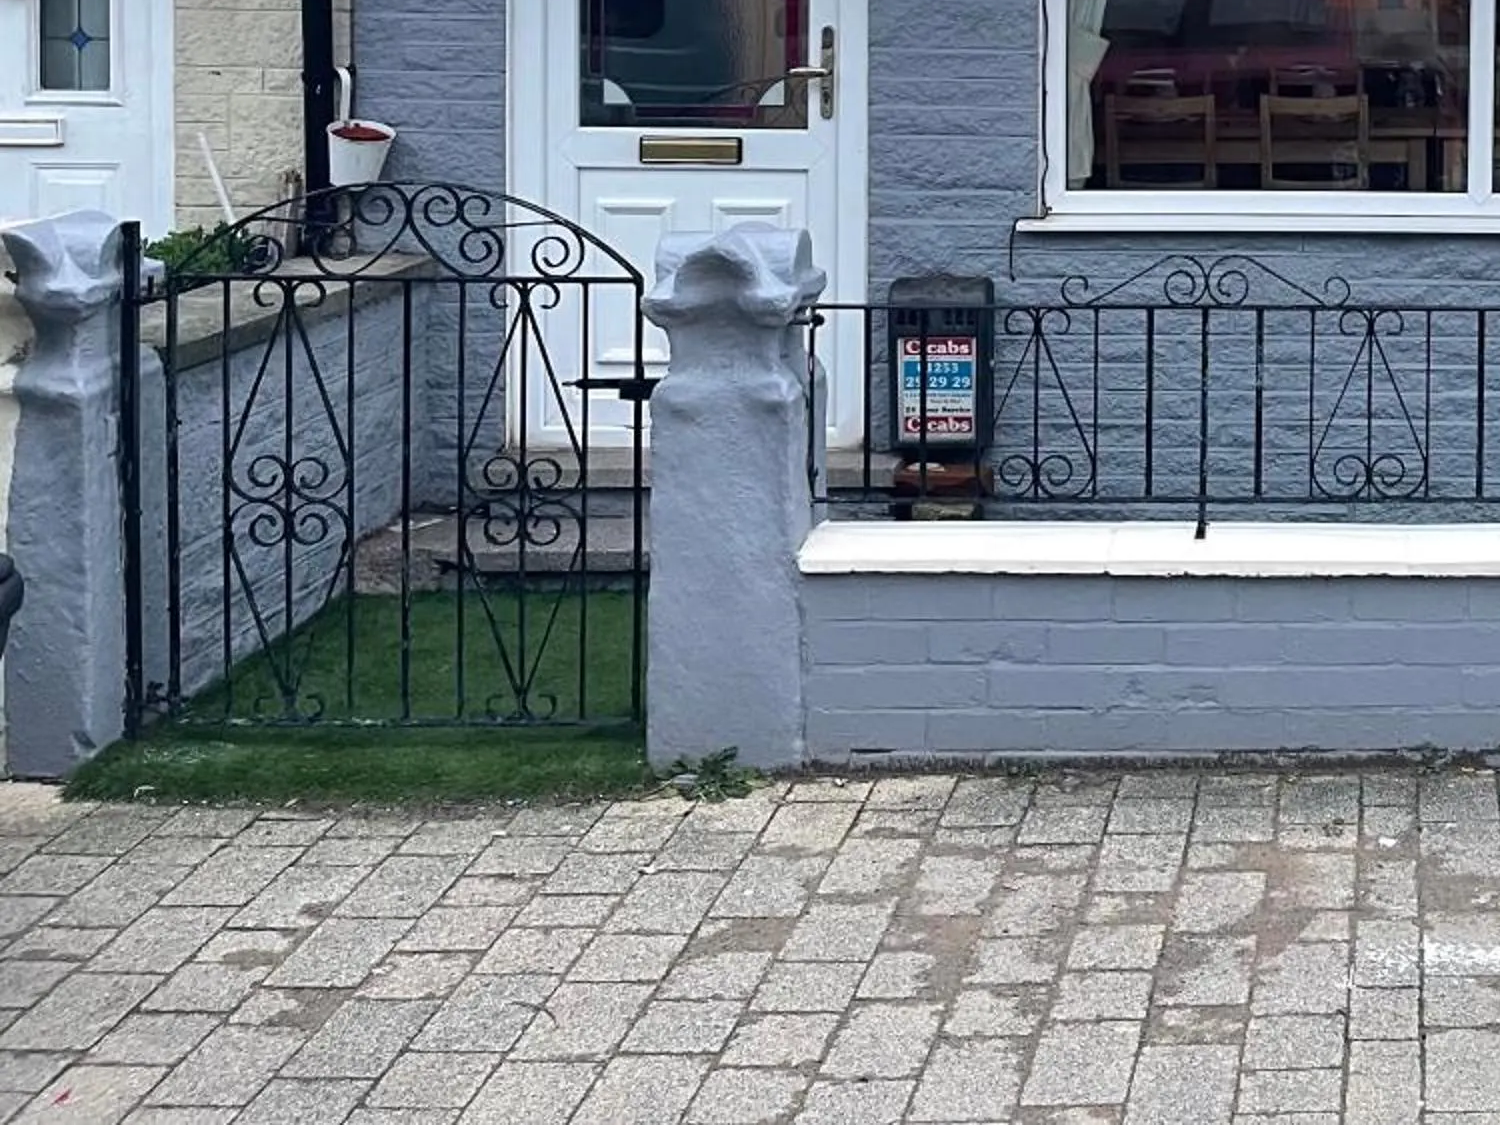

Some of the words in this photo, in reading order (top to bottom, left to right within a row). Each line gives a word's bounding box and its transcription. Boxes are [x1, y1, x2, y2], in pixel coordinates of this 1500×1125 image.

[927, 340, 970, 354] cabs
[929, 376, 948, 388] 29
[952, 376, 971, 388] 29
[927, 416, 970, 432] cabs
